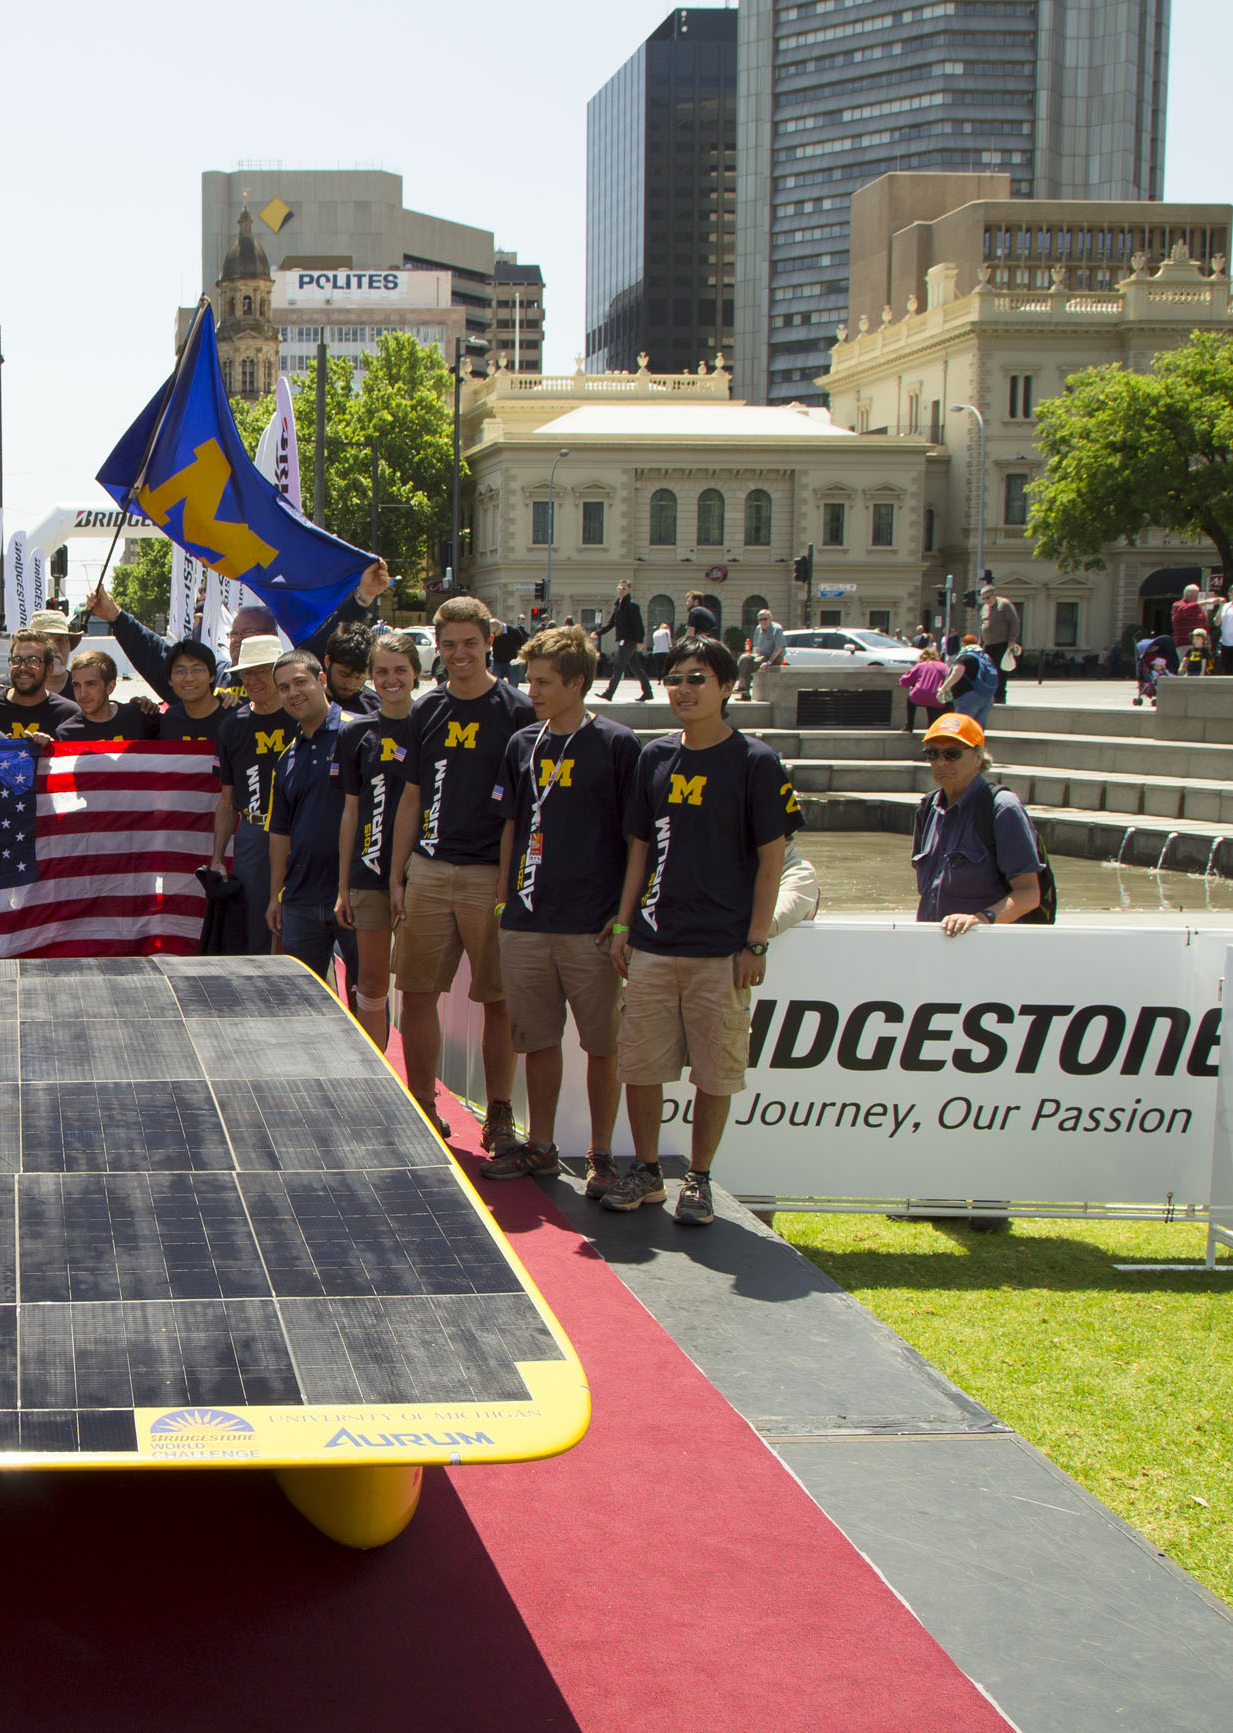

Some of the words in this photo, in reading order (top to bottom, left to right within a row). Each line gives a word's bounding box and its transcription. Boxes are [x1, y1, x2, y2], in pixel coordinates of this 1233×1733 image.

[298, 274, 399, 290] POLITES
[255, 729, 286, 754] M
[444, 721, 480, 749] M
[539, 759, 575, 787] M
[668, 774, 708, 806] M
[420, 759, 447, 857] AURUM
[361, 773, 386, 876] AURUM
[641, 816, 671, 933] AURUM
[746, 999, 1223, 1077] IDGESTONE
[735, 1093, 922, 1138] Journey,
[937, 1096, 1021, 1132] Our
[1031, 1098, 1193, 1134] Passion
[268, 1413, 394, 1424] UNIVERSITY
[401, 1412, 424, 1422] OF
[435, 1409, 543, 1421] MICHIGAN
[151, 1434, 256, 1443] BRIDGESTONE
[151, 1442, 205, 1450] WORLD
[324, 1427, 496, 1448] AURUM
[152, 1450, 261, 1459] CHALLENGE
